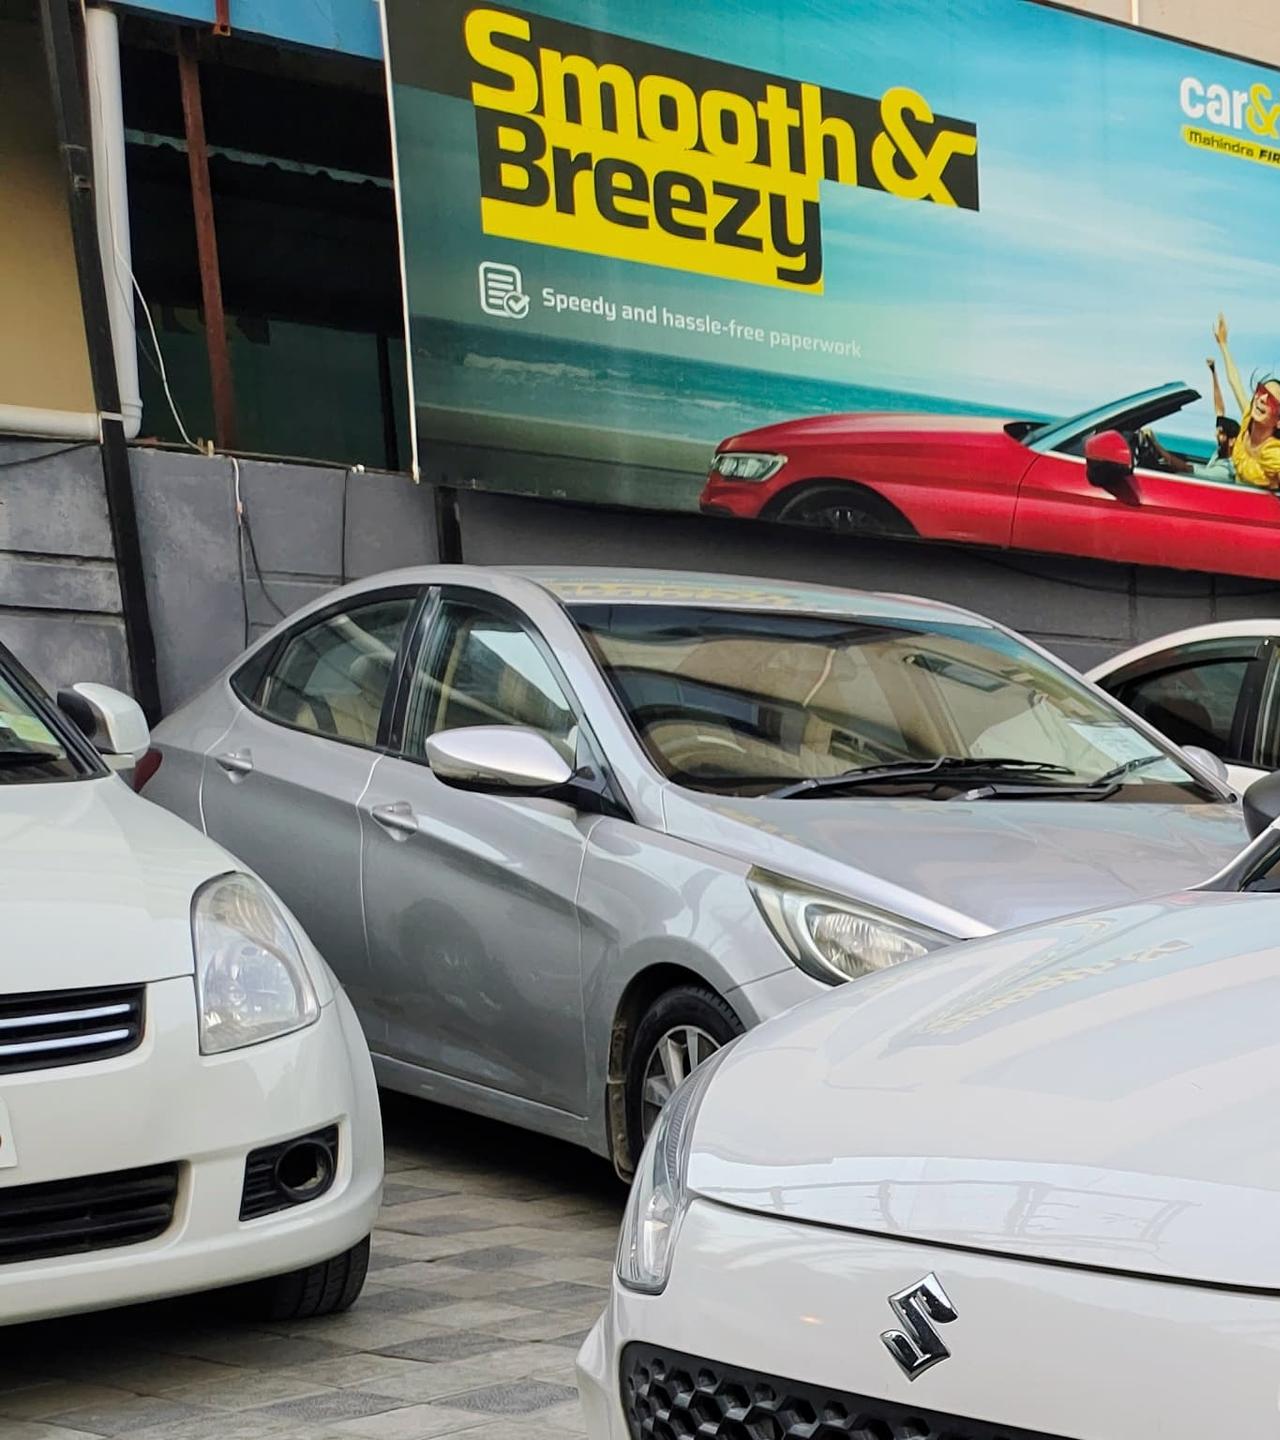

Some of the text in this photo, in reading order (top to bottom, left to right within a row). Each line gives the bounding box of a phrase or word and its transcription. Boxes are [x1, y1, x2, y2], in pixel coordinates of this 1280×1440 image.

[465, 9, 977, 207] Smooth &
[1189, 131, 1254, 157] Mahindra
[475, 107, 822, 284] Breezy
[542, 287, 862, 358] Speedy and hassle-free paperwork
